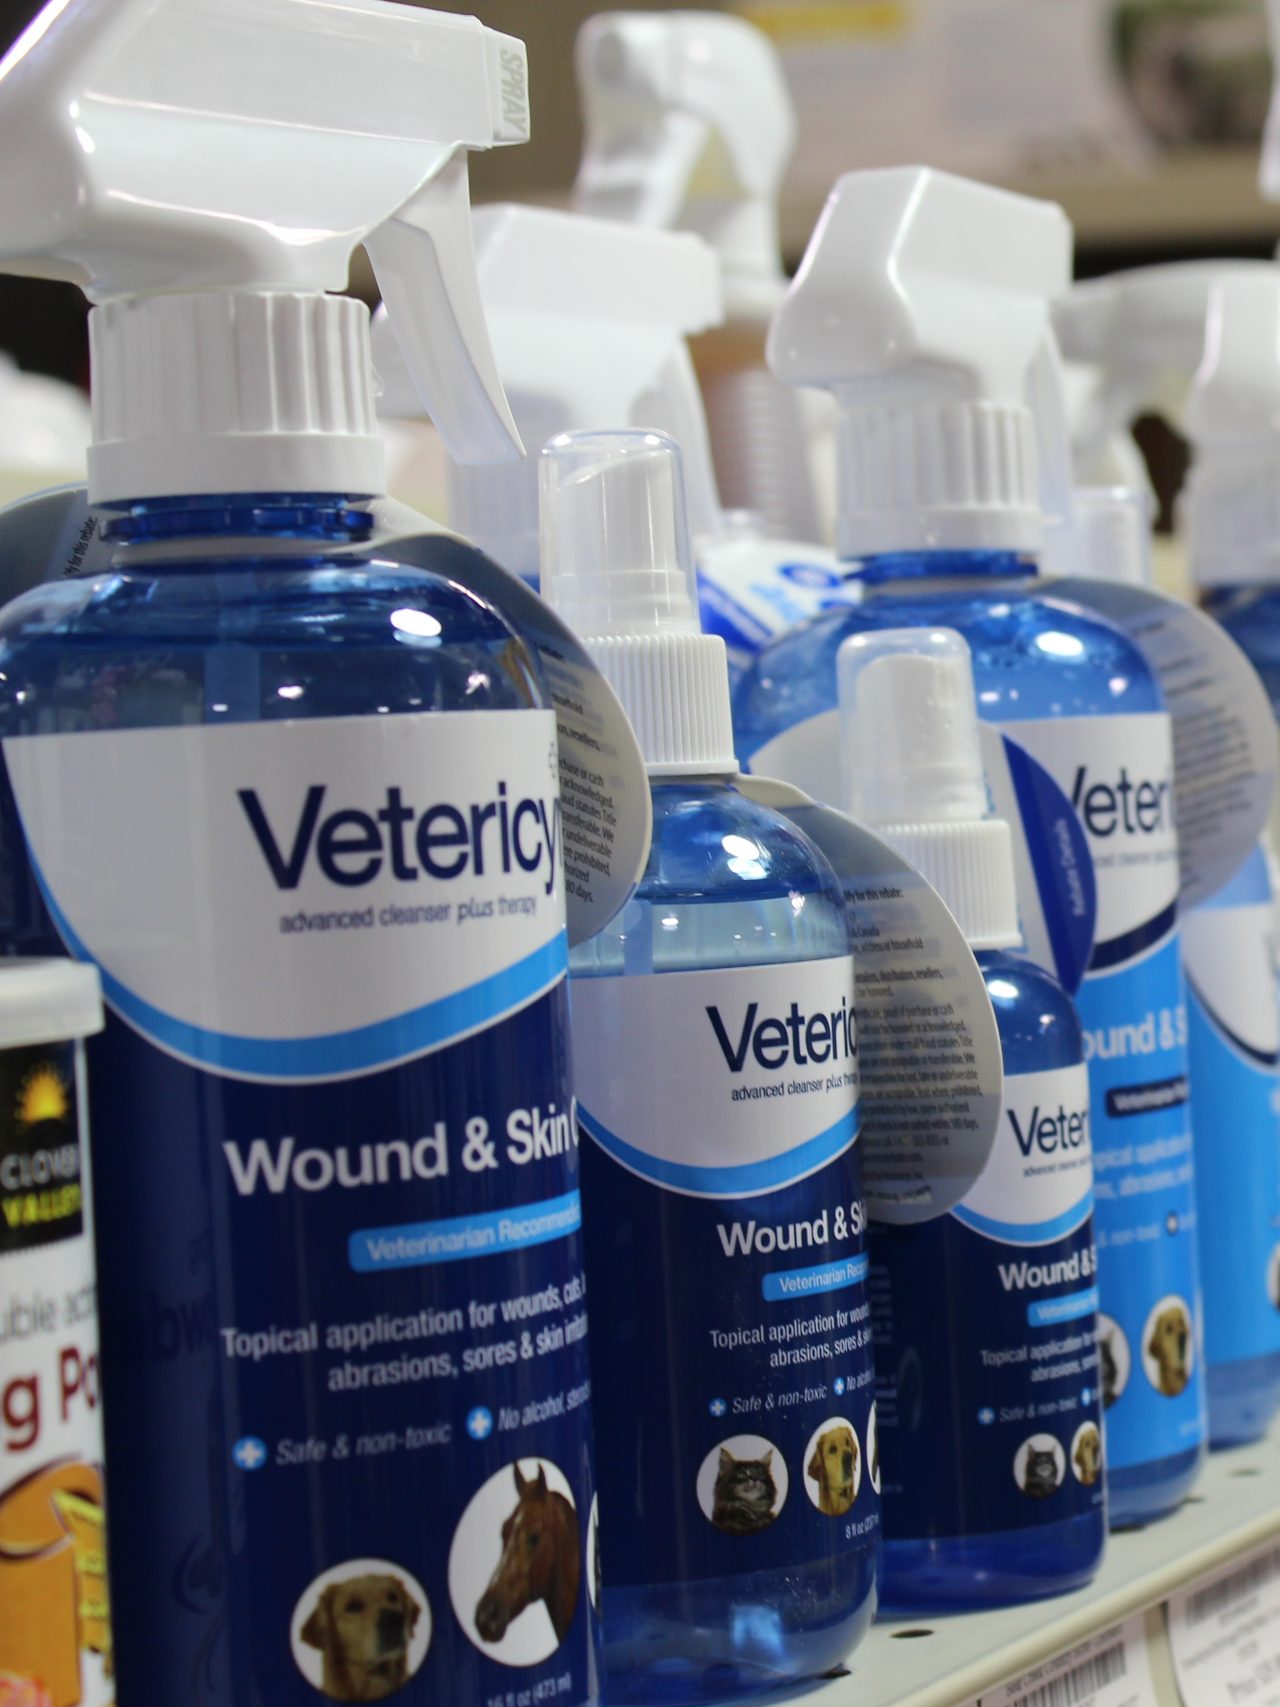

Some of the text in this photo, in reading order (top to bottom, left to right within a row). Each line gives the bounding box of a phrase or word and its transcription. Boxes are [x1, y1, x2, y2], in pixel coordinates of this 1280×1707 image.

[500, 48, 528, 135] SPRAY
[236, 780, 562, 896] Vetericy
[279, 894, 539, 934] advanced cleanser plus therapy
[731, 1081, 785, 1102] advanced
[787, 1078, 823, 1096] cleanser
[826, 1074, 843, 1094] plus
[222, 1121, 449, 1197] Wound
[461, 1115, 499, 1173] &
[506, 1102, 570, 1166] Skin
[366, 1224, 496, 1262] Veterinarian
[716, 1208, 829, 1259] Wound
[833, 1205, 849, 1241] &
[779, 1268, 847, 1293] Veterinarian
[998, 1250, 1080, 1291] Wound
[220, 1321, 318, 1363] Topical
[325, 1307, 464, 1353] application
[468, 1300, 498, 1329] for
[500, 1282, 564, 1323] wounds,
[709, 1324, 766, 1351] Topical
[768, 1312, 836, 1344] application
[836, 1308, 850, 1329] for
[327, 1352, 459, 1393] abrasions,
[462, 1340, 518, 1373] sores
[519, 1330, 534, 1361] &
[535, 1323, 565, 1356] skin
[769, 1342, 834, 1369] abrasions,
[834, 1334, 858, 1357] sores
[980, 1345, 1028, 1368] Topical
[498, 1406, 521, 1432] No
[731, 1383, 829, 1415] Safe & non-toxic
[275, 1419, 453, 1466] Safe & non-toxic
